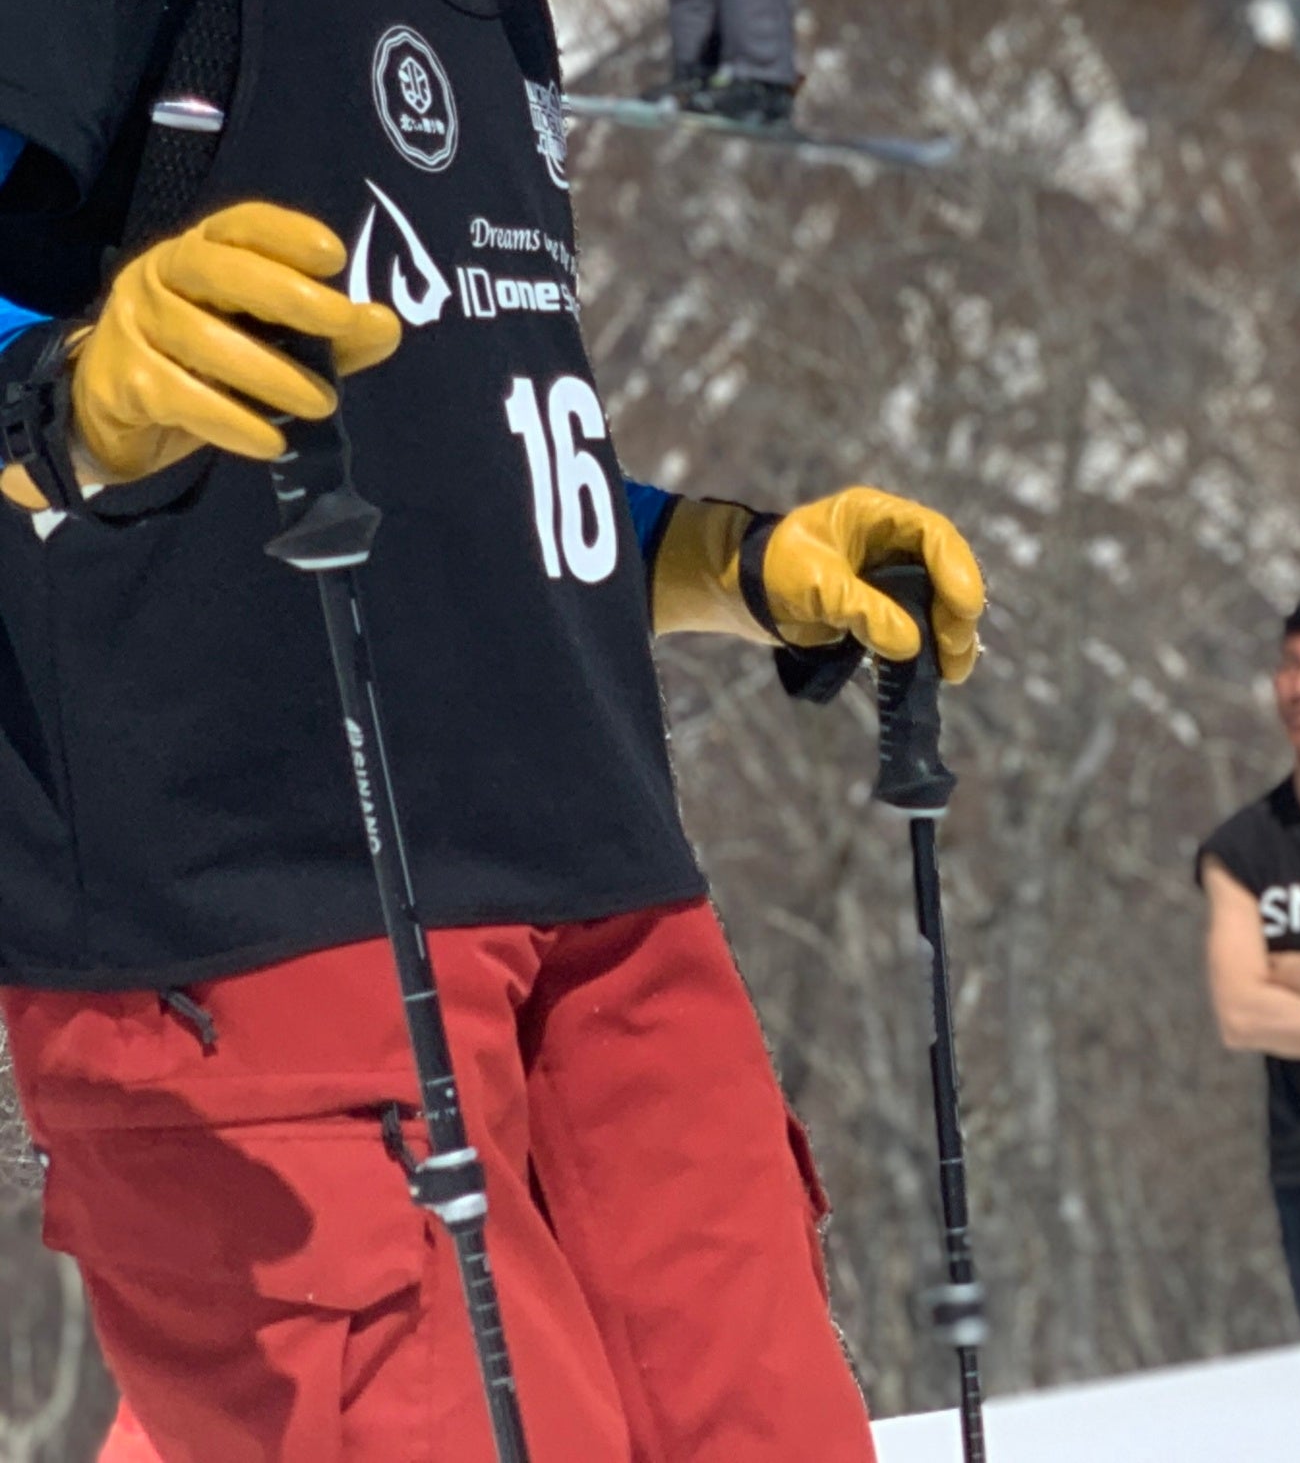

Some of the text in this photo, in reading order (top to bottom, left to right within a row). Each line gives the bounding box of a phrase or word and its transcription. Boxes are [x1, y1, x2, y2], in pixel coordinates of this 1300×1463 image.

[470, 217, 541, 251] Dreams
[504, 376, 618, 583] 16
[352, 751, 382, 855] SINANO
